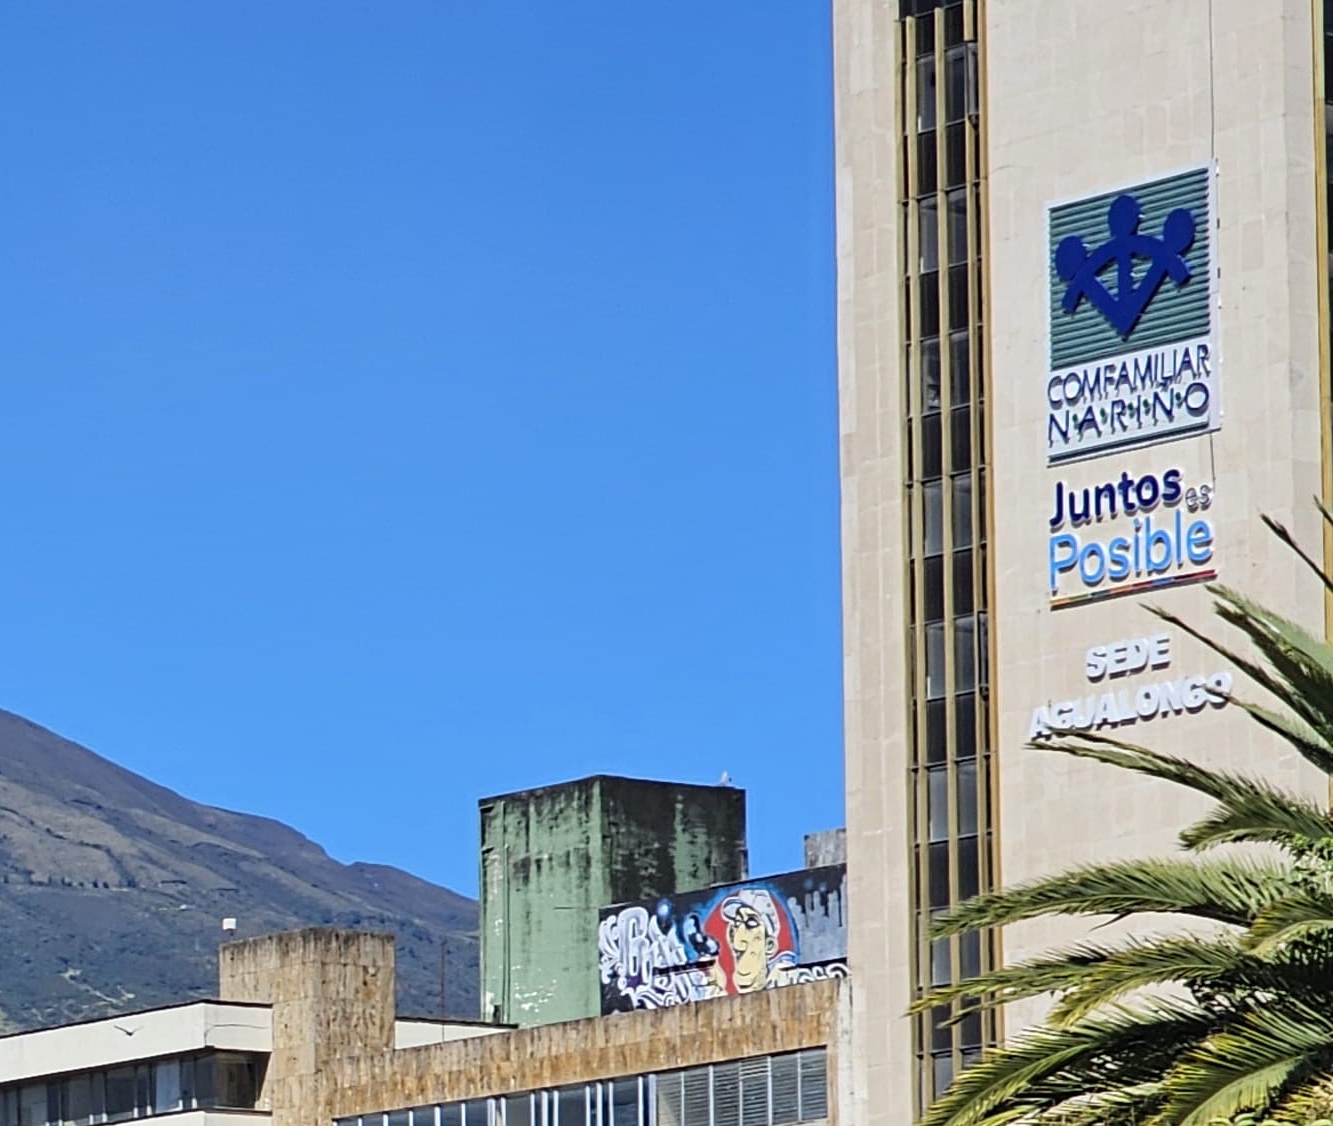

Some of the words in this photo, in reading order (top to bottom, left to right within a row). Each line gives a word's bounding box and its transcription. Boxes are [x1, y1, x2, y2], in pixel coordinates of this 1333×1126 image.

[1047, 343, 1211, 410] COMFAMILIAR
[1049, 468, 1182, 530] Juntos
[1185, 483, 1212, 512] es
[1048, 509, 1214, 596] Posible
[1085, 634, 1171, 683] SEDE
